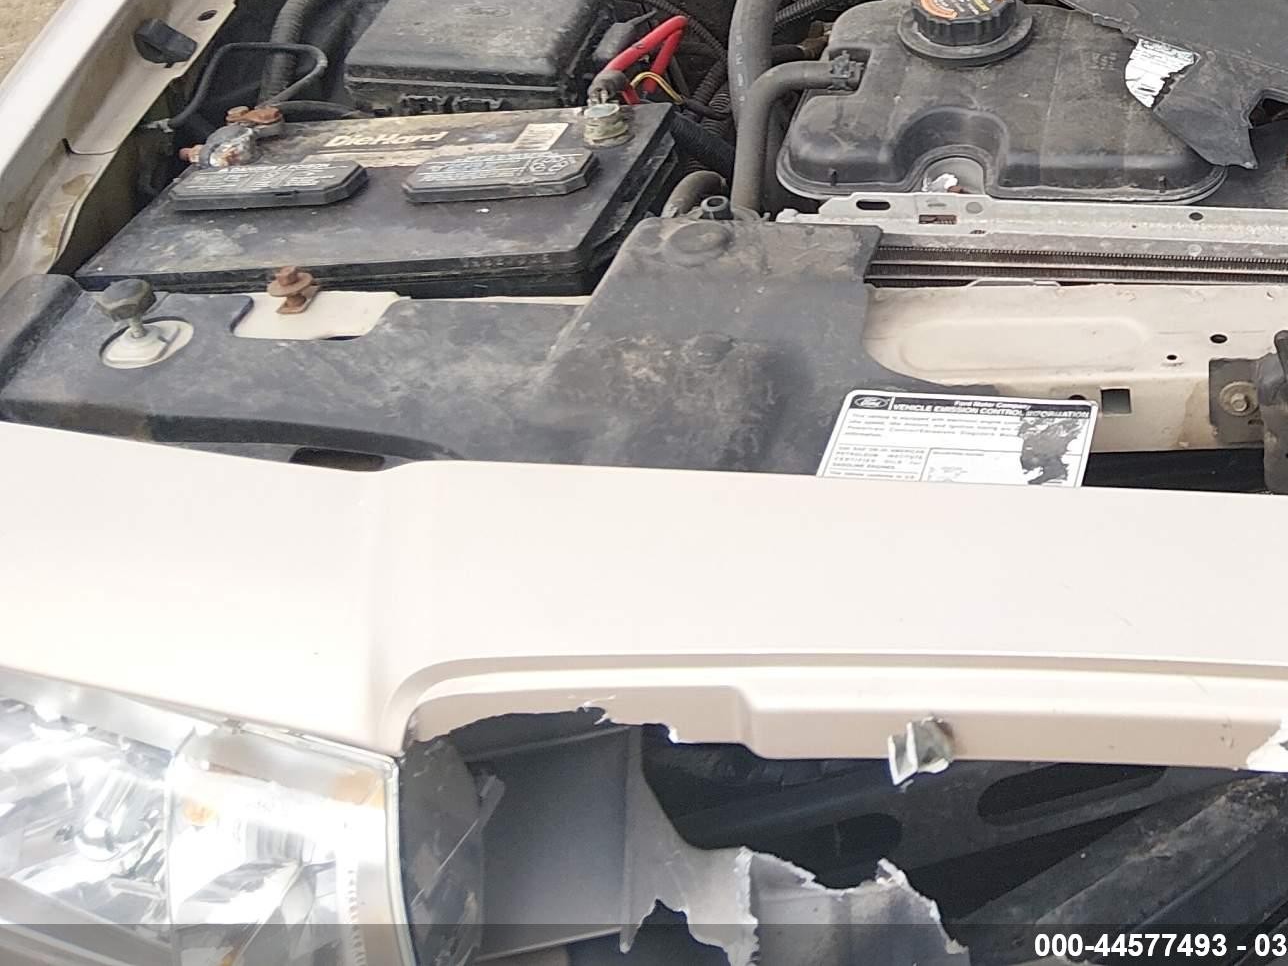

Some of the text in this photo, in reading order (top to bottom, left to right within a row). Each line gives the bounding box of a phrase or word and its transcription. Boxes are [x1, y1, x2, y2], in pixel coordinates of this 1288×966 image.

[323, 132, 449, 147] DieHard
[893, 404, 932, 412] VEHICLE
[933, 405, 979, 414] EMISSION
[979, 407, 1024, 417] CONTROL
